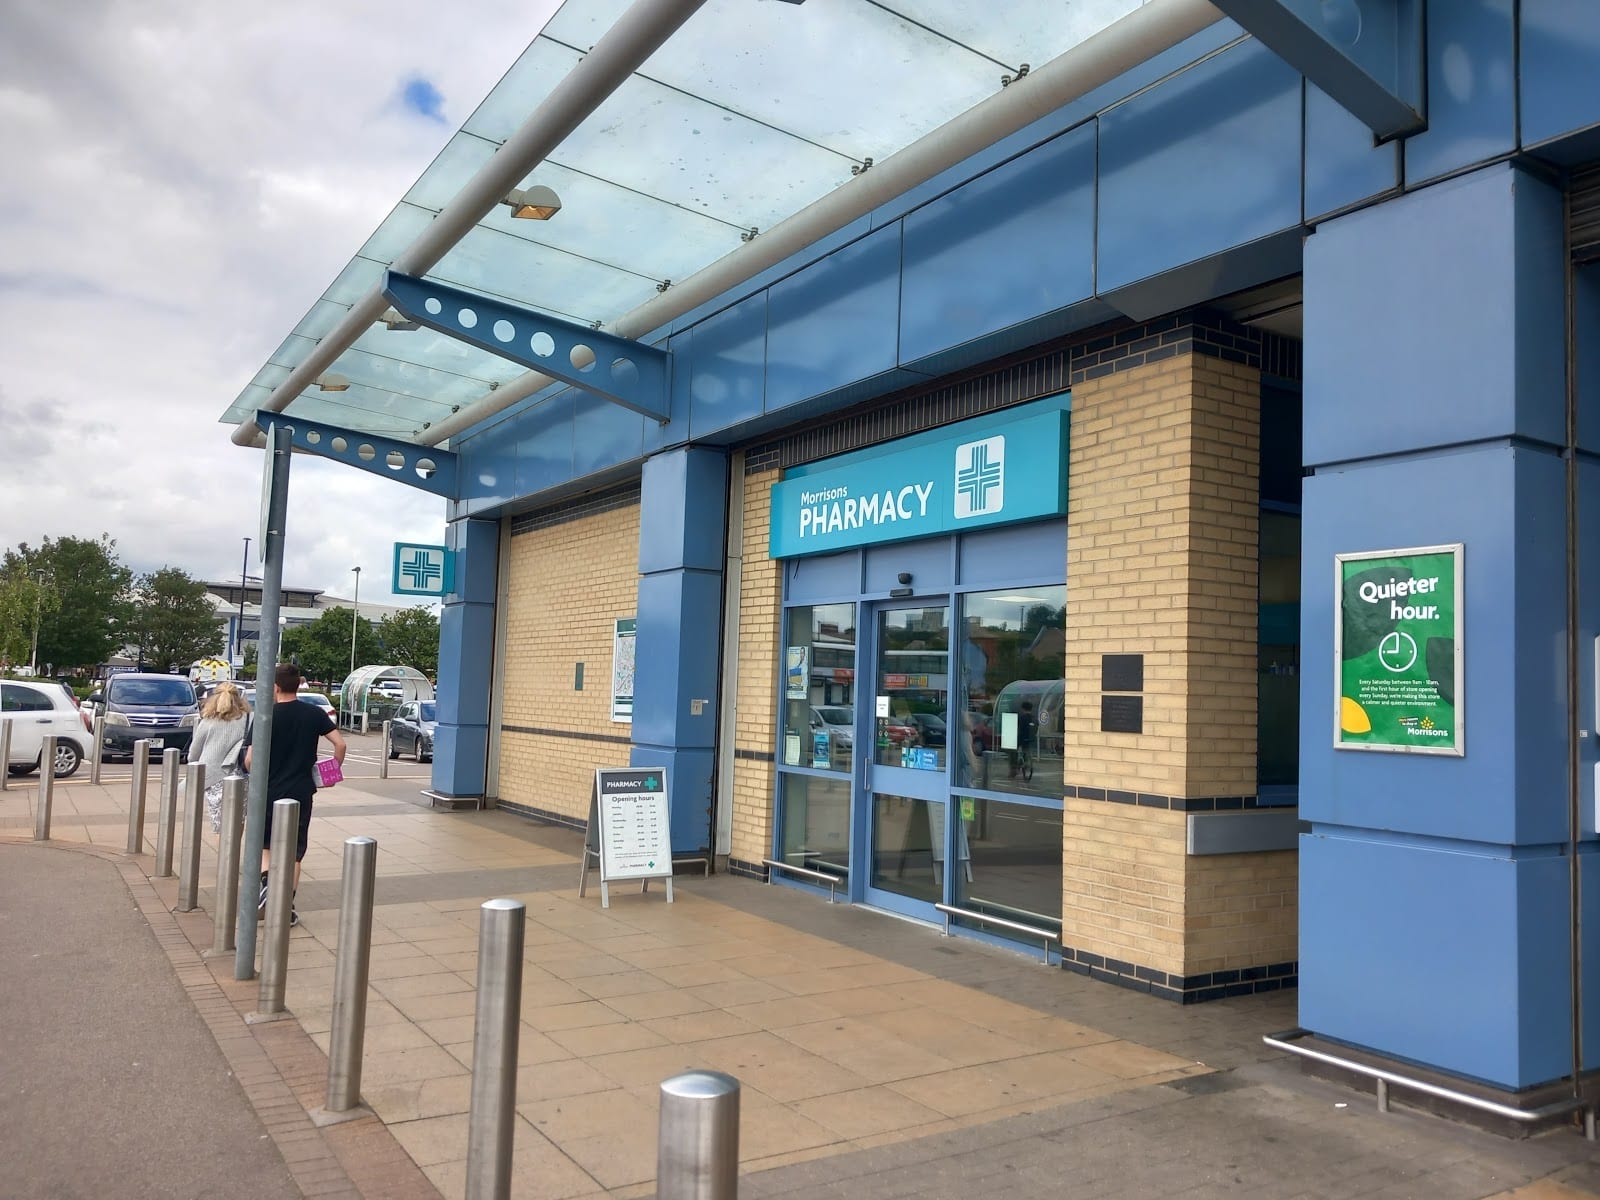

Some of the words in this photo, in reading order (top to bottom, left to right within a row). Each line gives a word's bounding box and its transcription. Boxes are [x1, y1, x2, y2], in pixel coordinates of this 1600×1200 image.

[801, 486, 848, 506] Morrisons
[799, 481, 934, 538] PHARMACY
[1359, 577, 1439, 604] Quieter
[1390, 600, 1440, 620] hour.
[1407, 728, 1448, 737] Morrisons
[611, 796, 637, 804] Opening
